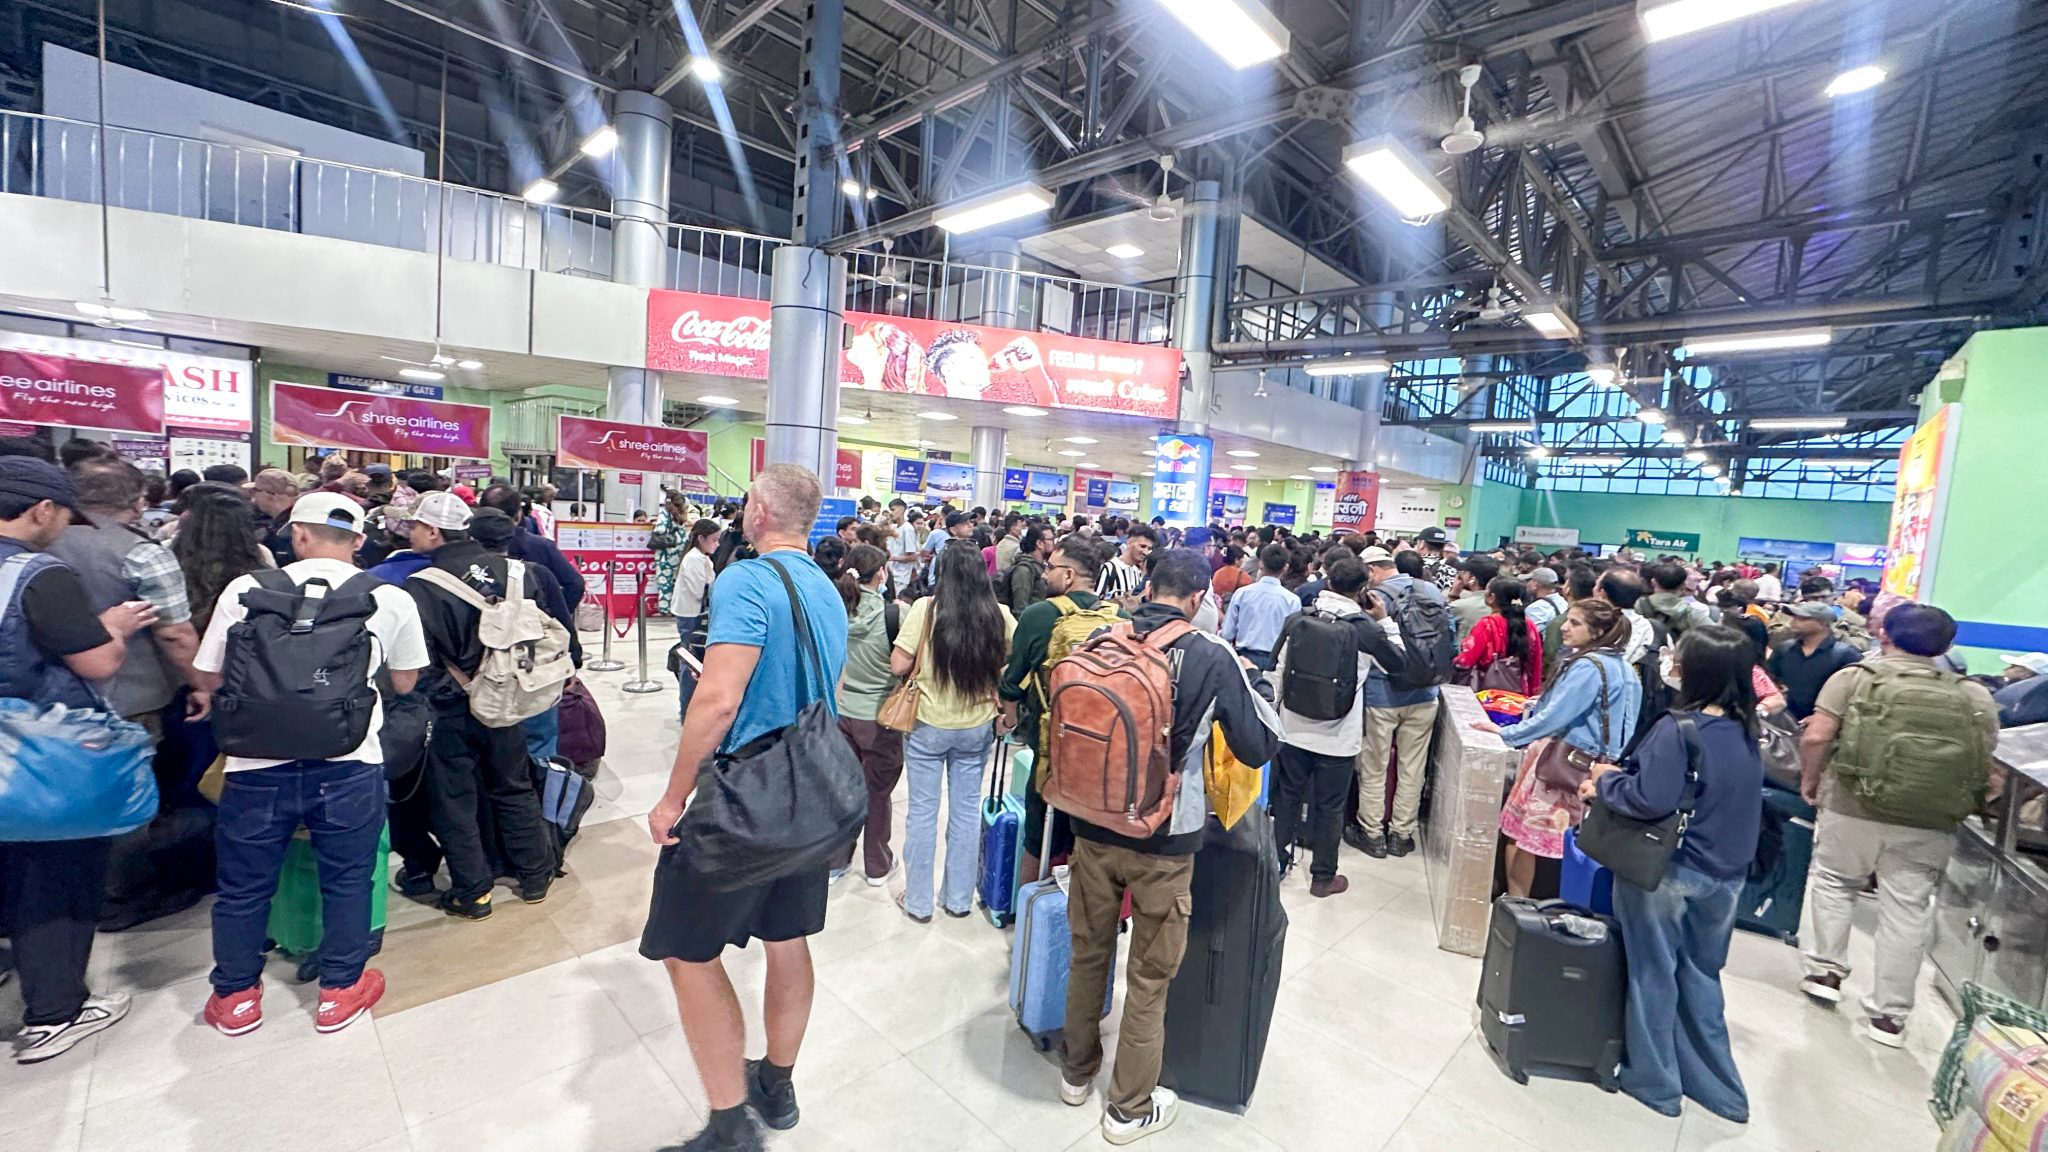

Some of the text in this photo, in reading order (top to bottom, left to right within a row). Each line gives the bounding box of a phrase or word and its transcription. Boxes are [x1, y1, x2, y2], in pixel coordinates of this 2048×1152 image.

[413, 385, 436, 396] GATE
[12, 391, 37, 405] Fly
[1650, 537, 1671, 547] Tara
[1672, 539, 1689, 548] Air
